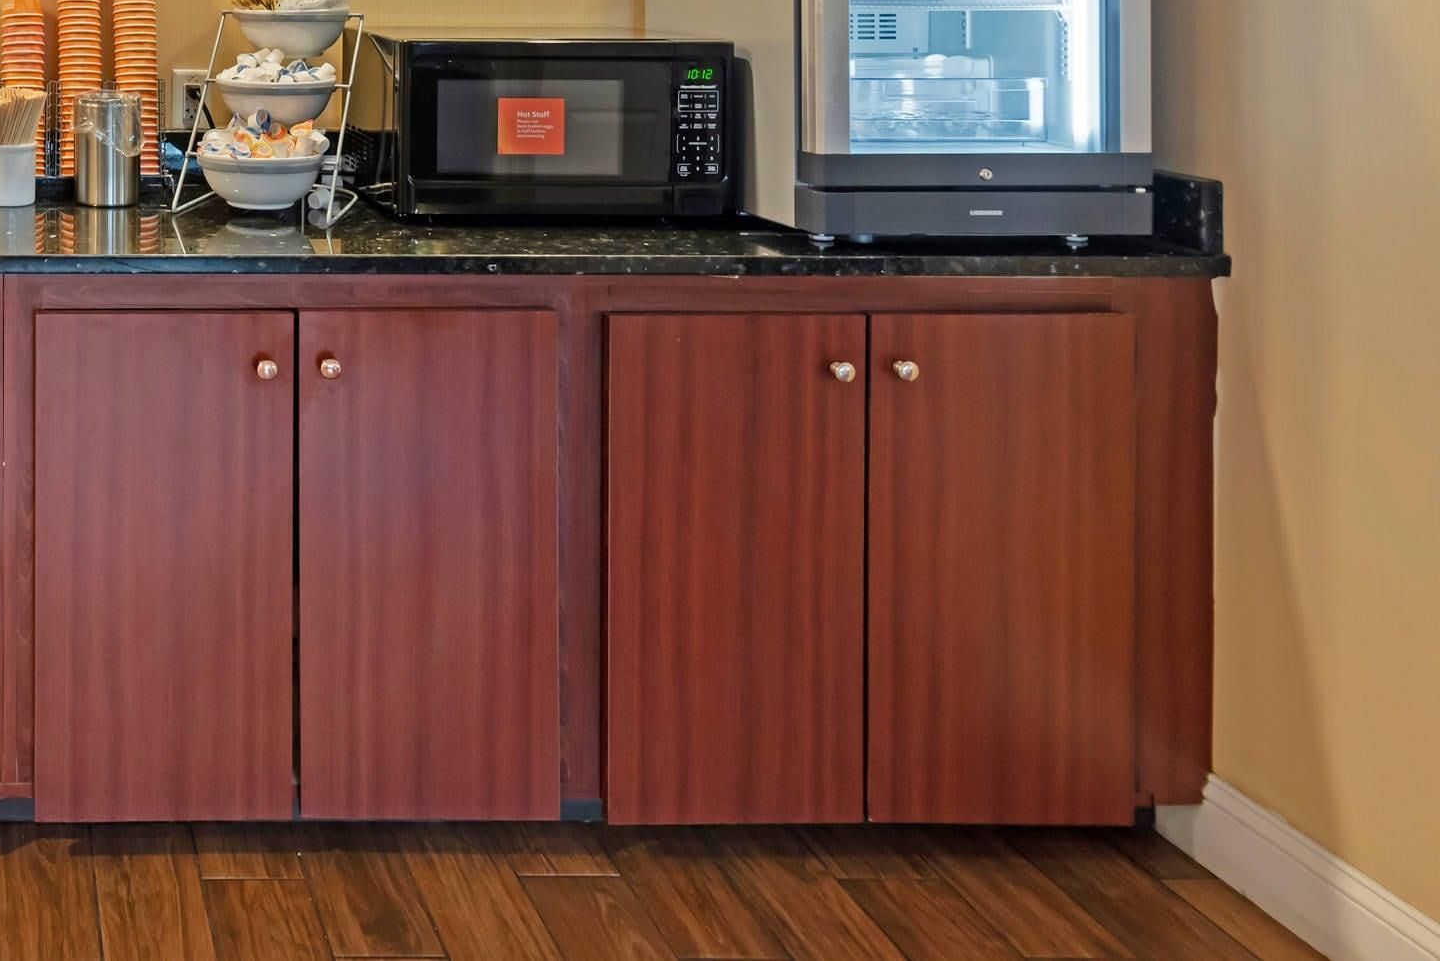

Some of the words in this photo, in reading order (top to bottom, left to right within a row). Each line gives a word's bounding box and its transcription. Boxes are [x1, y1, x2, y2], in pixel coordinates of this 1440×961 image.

[687, 68, 713, 80] 10:12
[517, 110, 531, 118] Hot
[531, 110, 550, 118] Stuff
